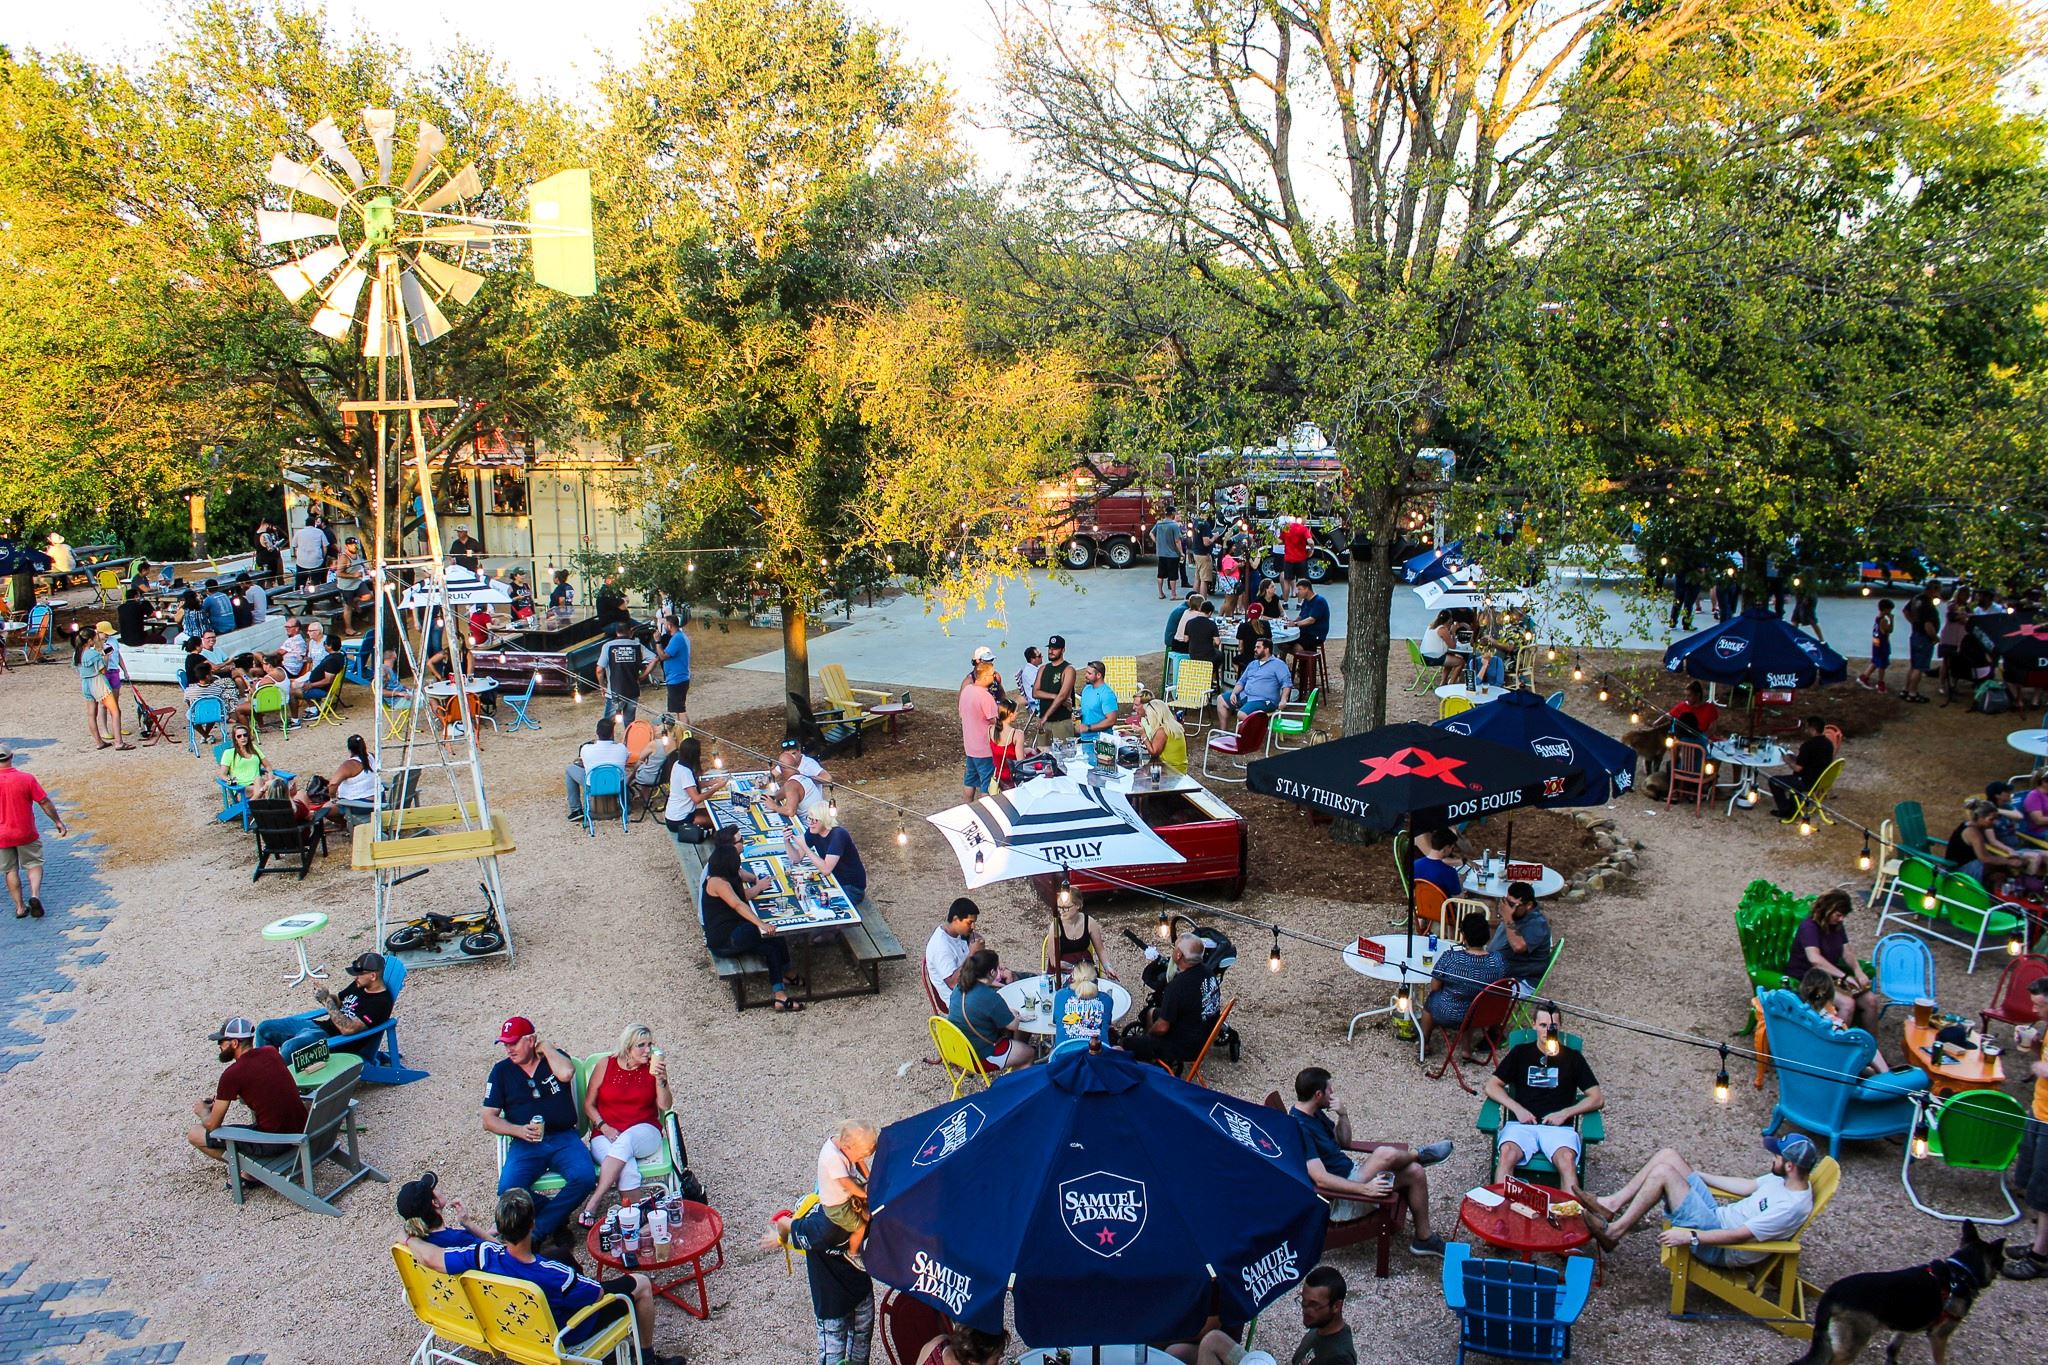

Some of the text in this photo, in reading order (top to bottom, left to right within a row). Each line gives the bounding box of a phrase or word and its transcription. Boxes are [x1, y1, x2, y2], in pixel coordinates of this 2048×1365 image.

[448, 592, 472, 600] RULY
[1466, 594, 1500, 603] TRY
[1767, 672, 1798, 682] SAMUEL
[1769, 680, 1797, 688] ADAMS
[1535, 743, 1569, 753] SAMUEL
[1542, 749, 1570, 758] ADAMS
[1276, 777, 1370, 817] STAY THIRSTY
[1448, 789, 1522, 819] DOS EQUIS
[1039, 841, 1103, 862] TRULY
[1508, 867, 1542, 878] TRK YRD
[503, 1022, 512, 1033] T
[295, 1044, 328, 1068] TRK YRD
[939, 1124, 955, 1156] ADAMS
[952, 1111, 967, 1151] SAMUEL
[1065, 1190, 1142, 1210] SAMUEL
[1072, 1206, 1138, 1226] ADAMS
[912, 1250, 972, 1301] SAMUEL
[1242, 1240, 1298, 1291] SAMUEL
[909, 1273, 967, 1315] ADAMS
[1252, 1260, 1299, 1308] ADAMS
